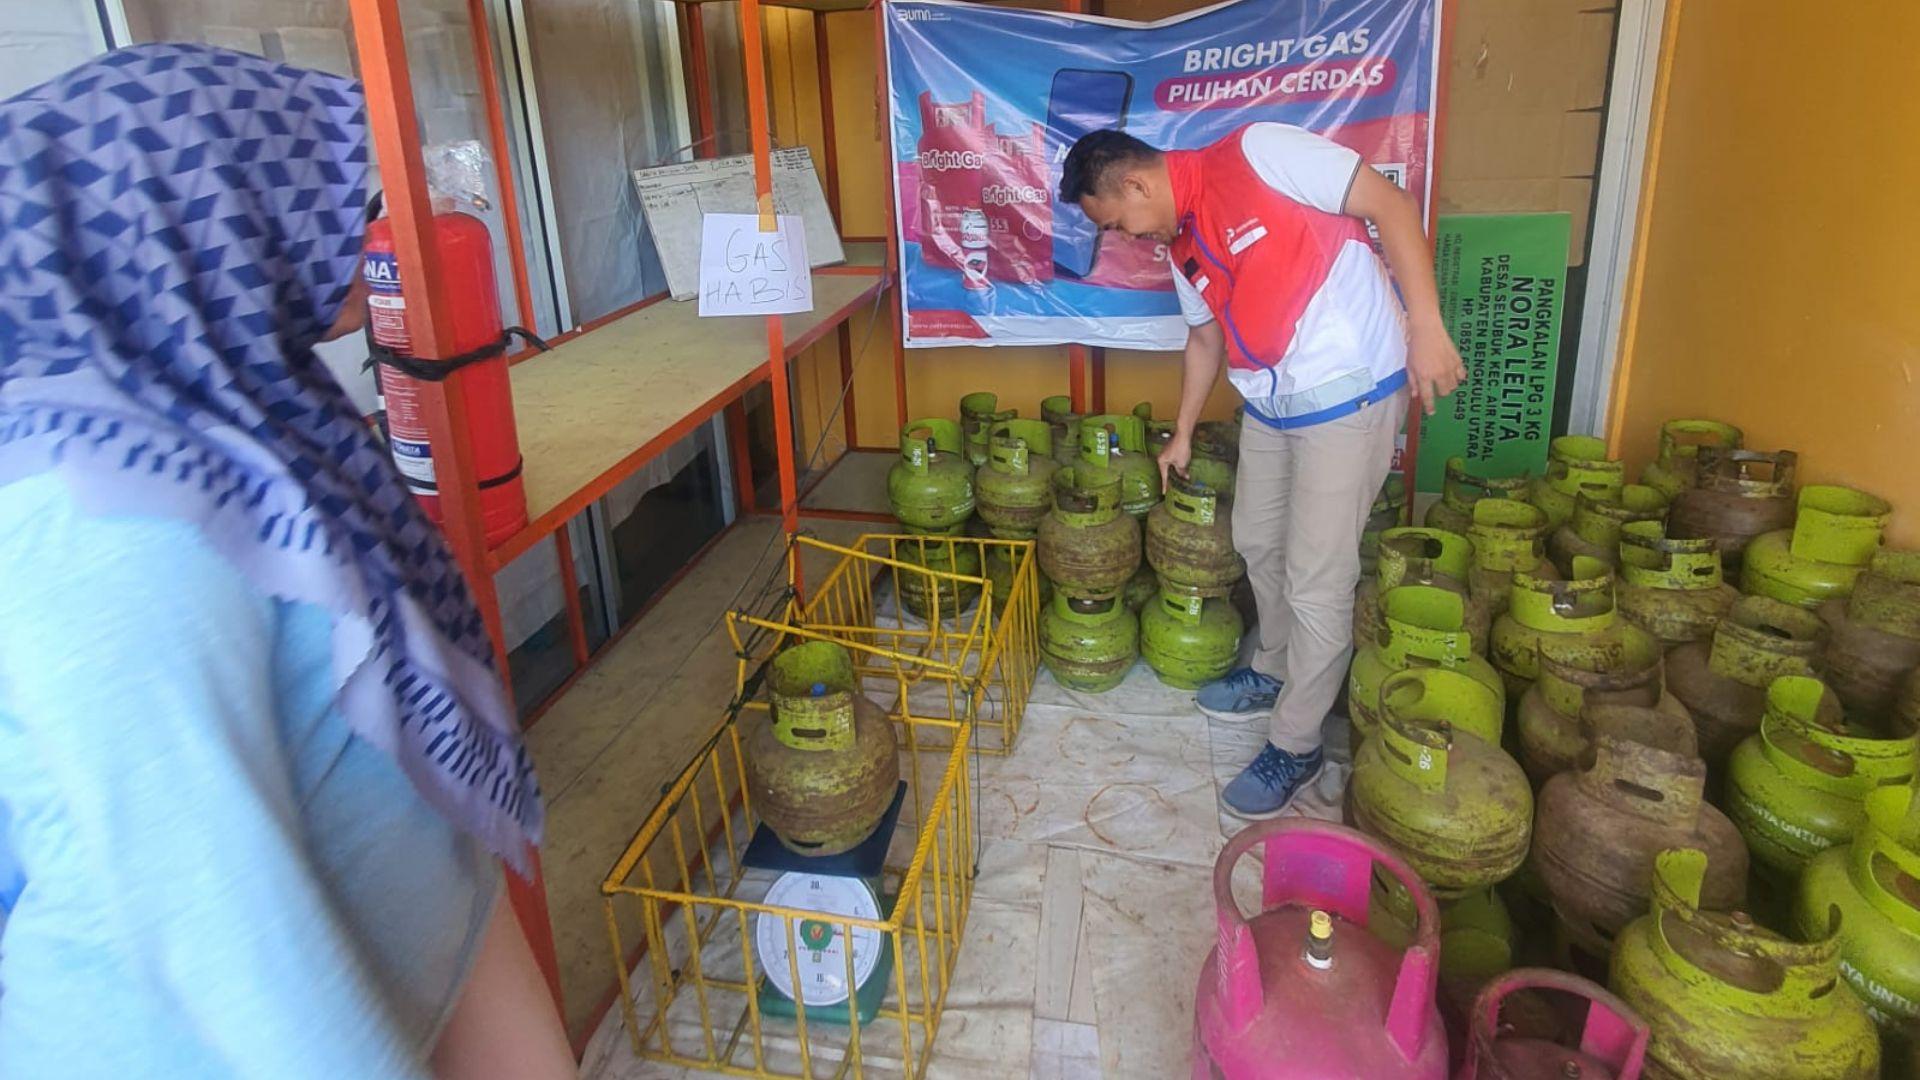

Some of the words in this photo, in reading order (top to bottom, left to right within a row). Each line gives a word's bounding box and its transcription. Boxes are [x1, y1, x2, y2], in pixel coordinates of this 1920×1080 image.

[1184, 38, 1294, 73] BRIGHT
[1302, 28, 1371, 58] GAS
[1168, 75, 1272, 103] PILIHAN
[1280, 64, 1385, 93] CERDAS
[921, 150, 959, 169] Bright
[963, 151, 984, 168] Ga
[982, 185, 1019, 206] Bright
[726, 228, 788, 273] GAS
[1495, 254, 1510, 290] DESA
[705, 277, 807, 308] HABIS
[1475, 257, 1494, 338] KABUPATEN
[1491, 294, 1507, 356] SELUBUK
[1506, 277, 1534, 349] NORA
[1531, 278, 1555, 370] PANGKALAN
[1470, 342, 1487, 413] BENGKULU
[1527, 375, 1545, 403] LPG
[1454, 390, 1467, 421] 0449
[1486, 395, 1497, 417] AIR
[1498, 358, 1526, 441] LELITA
[1527, 408, 1542, 416] 3
[1467, 417, 1480, 459] UTARA
[1482, 421, 1496, 462] NAPAL
[1524, 420, 1542, 441] KG
